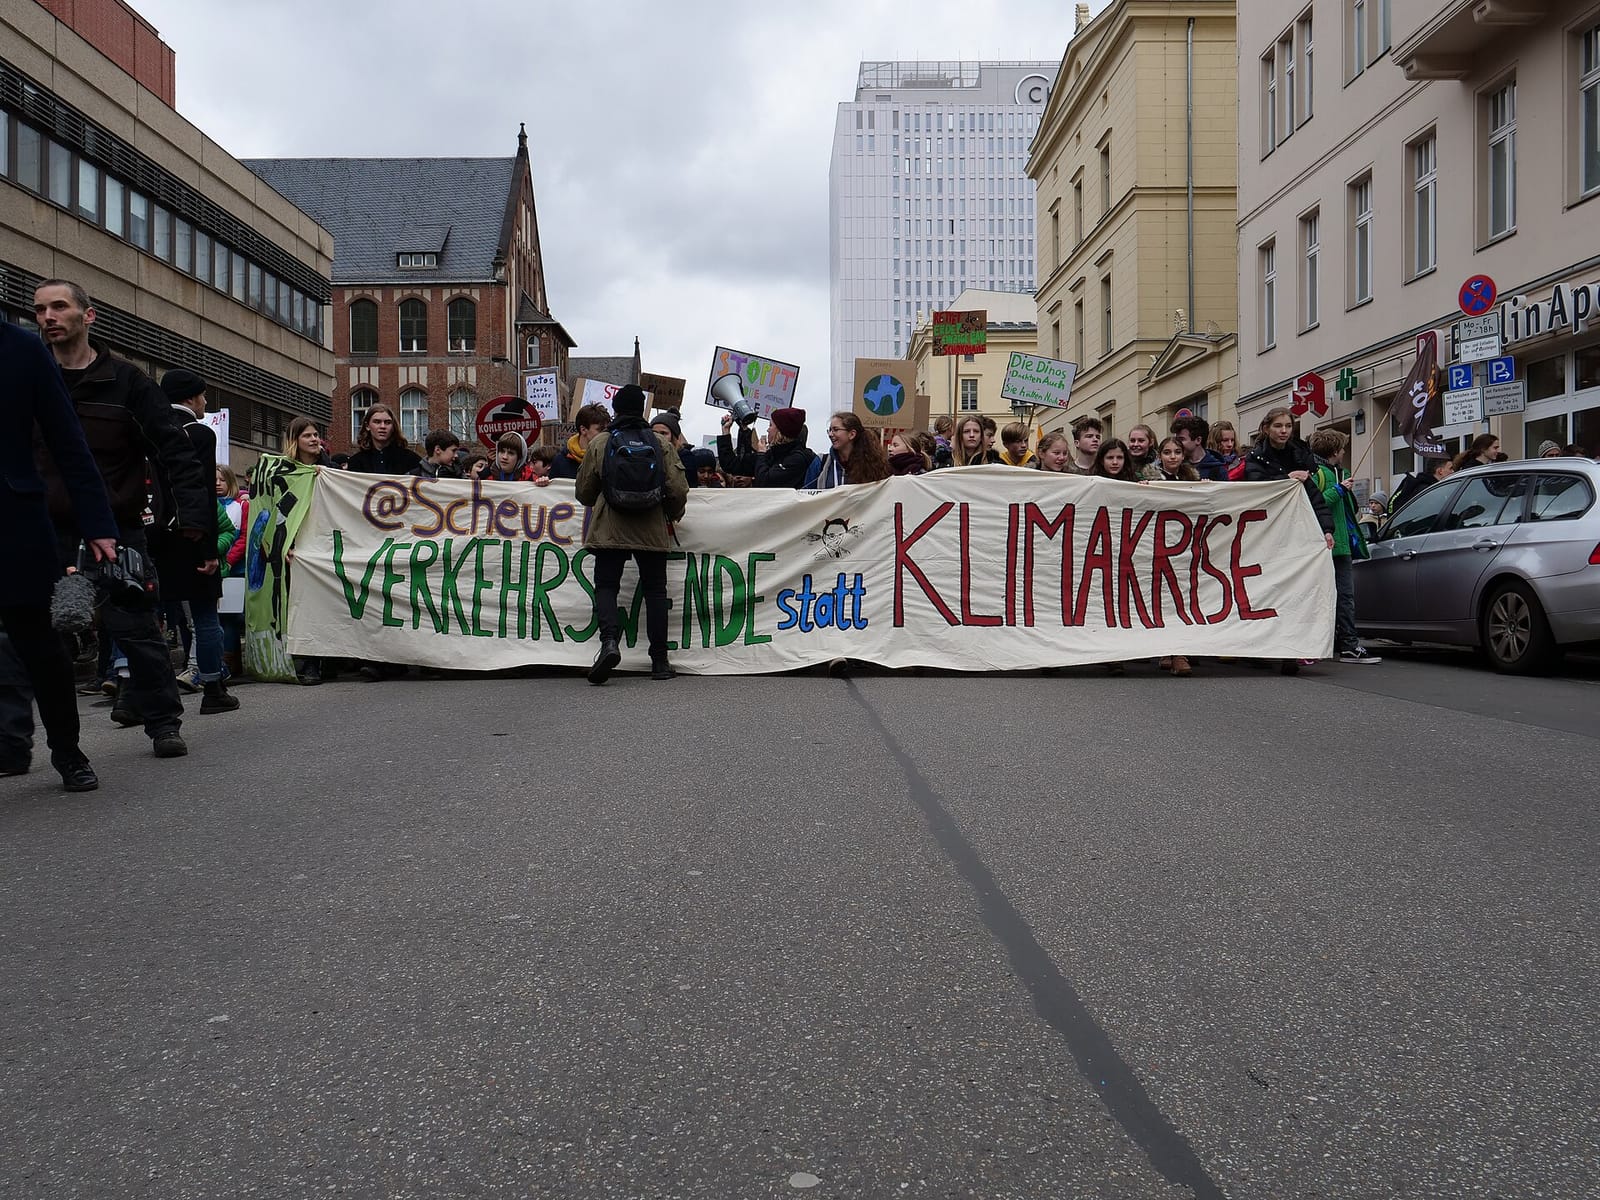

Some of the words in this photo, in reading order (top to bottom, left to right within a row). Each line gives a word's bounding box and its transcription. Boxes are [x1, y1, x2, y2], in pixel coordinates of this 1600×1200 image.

[1483, 317, 1491, 325] Fr
[1480, 325, 1494, 334] 18h
[718, 351, 796, 391] STOPPT
[1011, 354, 1033, 371] Die
[1036, 361, 1067, 379] Dinos
[527, 375, 554, 386] Autos
[1042, 376, 1065, 390] Auch
[1005, 384, 1018, 394] Sie
[478, 422, 501, 433] KOHLE
[503, 420, 538, 431] STOPPEN!
[893, 502, 1278, 629] KLIMAKRISE
[776, 573, 868, 633] statt
